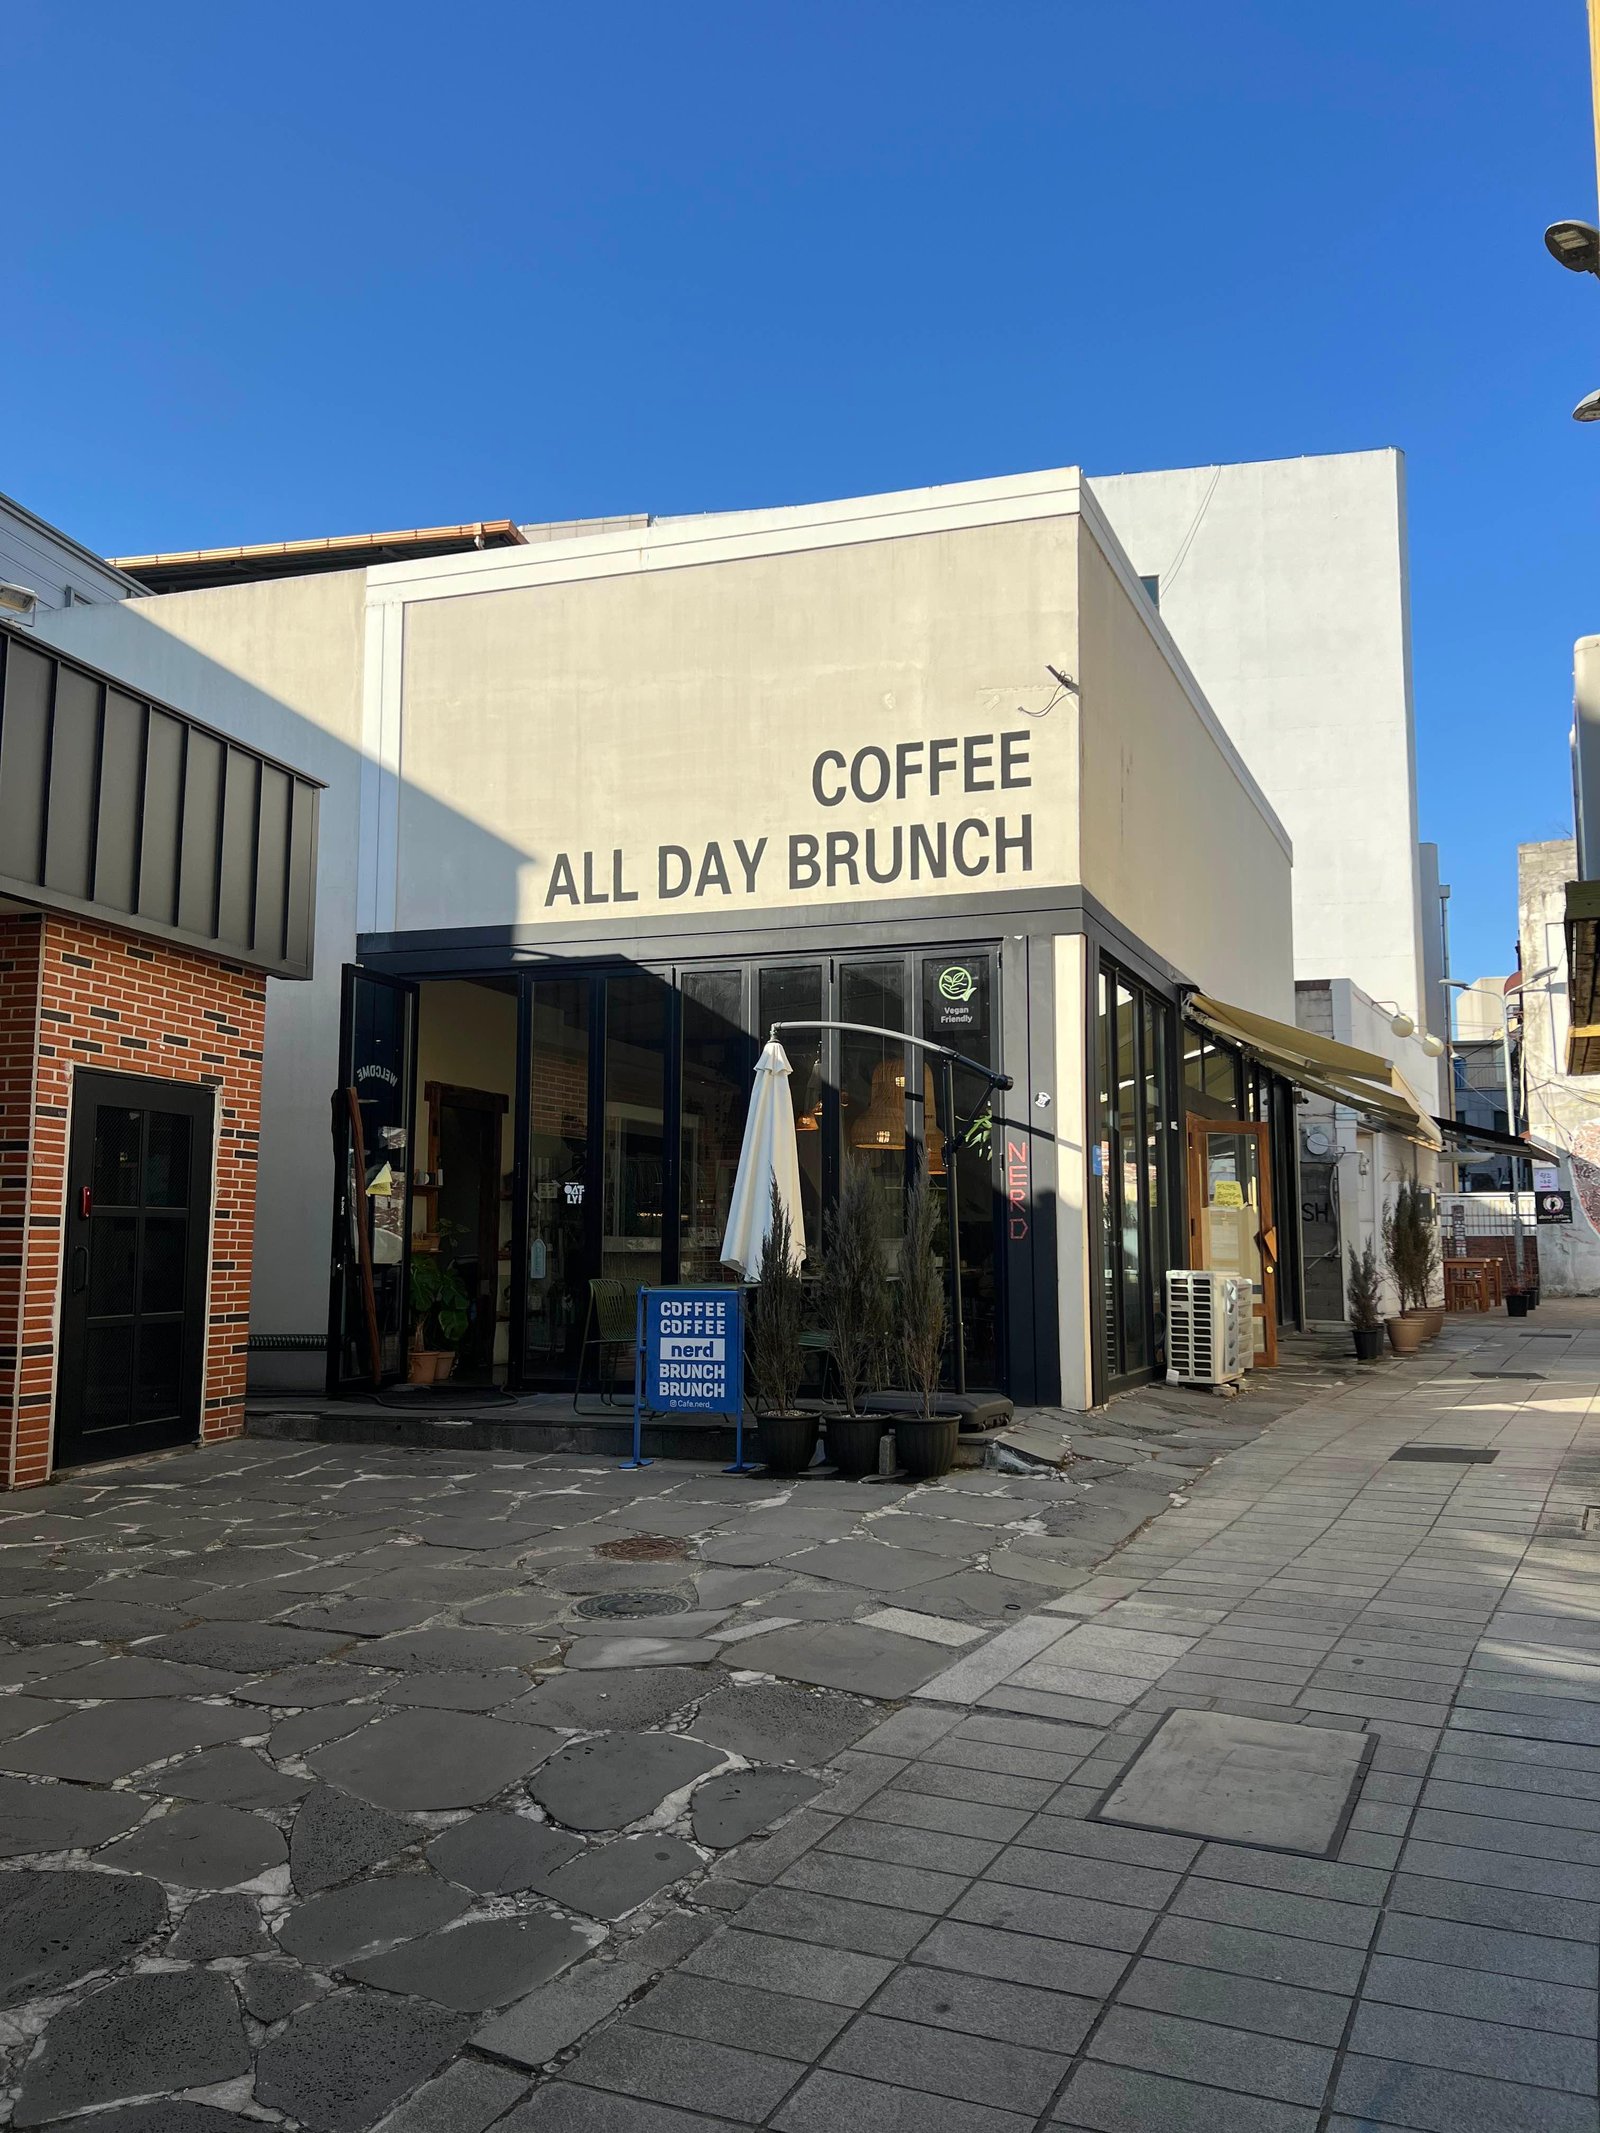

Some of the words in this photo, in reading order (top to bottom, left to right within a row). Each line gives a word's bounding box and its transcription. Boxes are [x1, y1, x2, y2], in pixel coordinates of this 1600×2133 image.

[812, 730, 1032, 806] COFFEE
[544, 849, 639, 907] ALL
[657, 837, 769, 900] DAY
[788, 814, 1032, 889] BRUNCH
[940, 1015, 973, 1024] Friendly
[1007, 1141, 1028, 1239] NERD
[1302, 1202, 1329, 1223] SH
[660, 1301, 726, 1317] COFFEE
[660, 1319, 726, 1335] COFFEE
[671, 1341, 714, 1358] nerd
[659, 1363, 726, 1379] BRUNCH
[659, 1381, 726, 1398] BRUNCH
